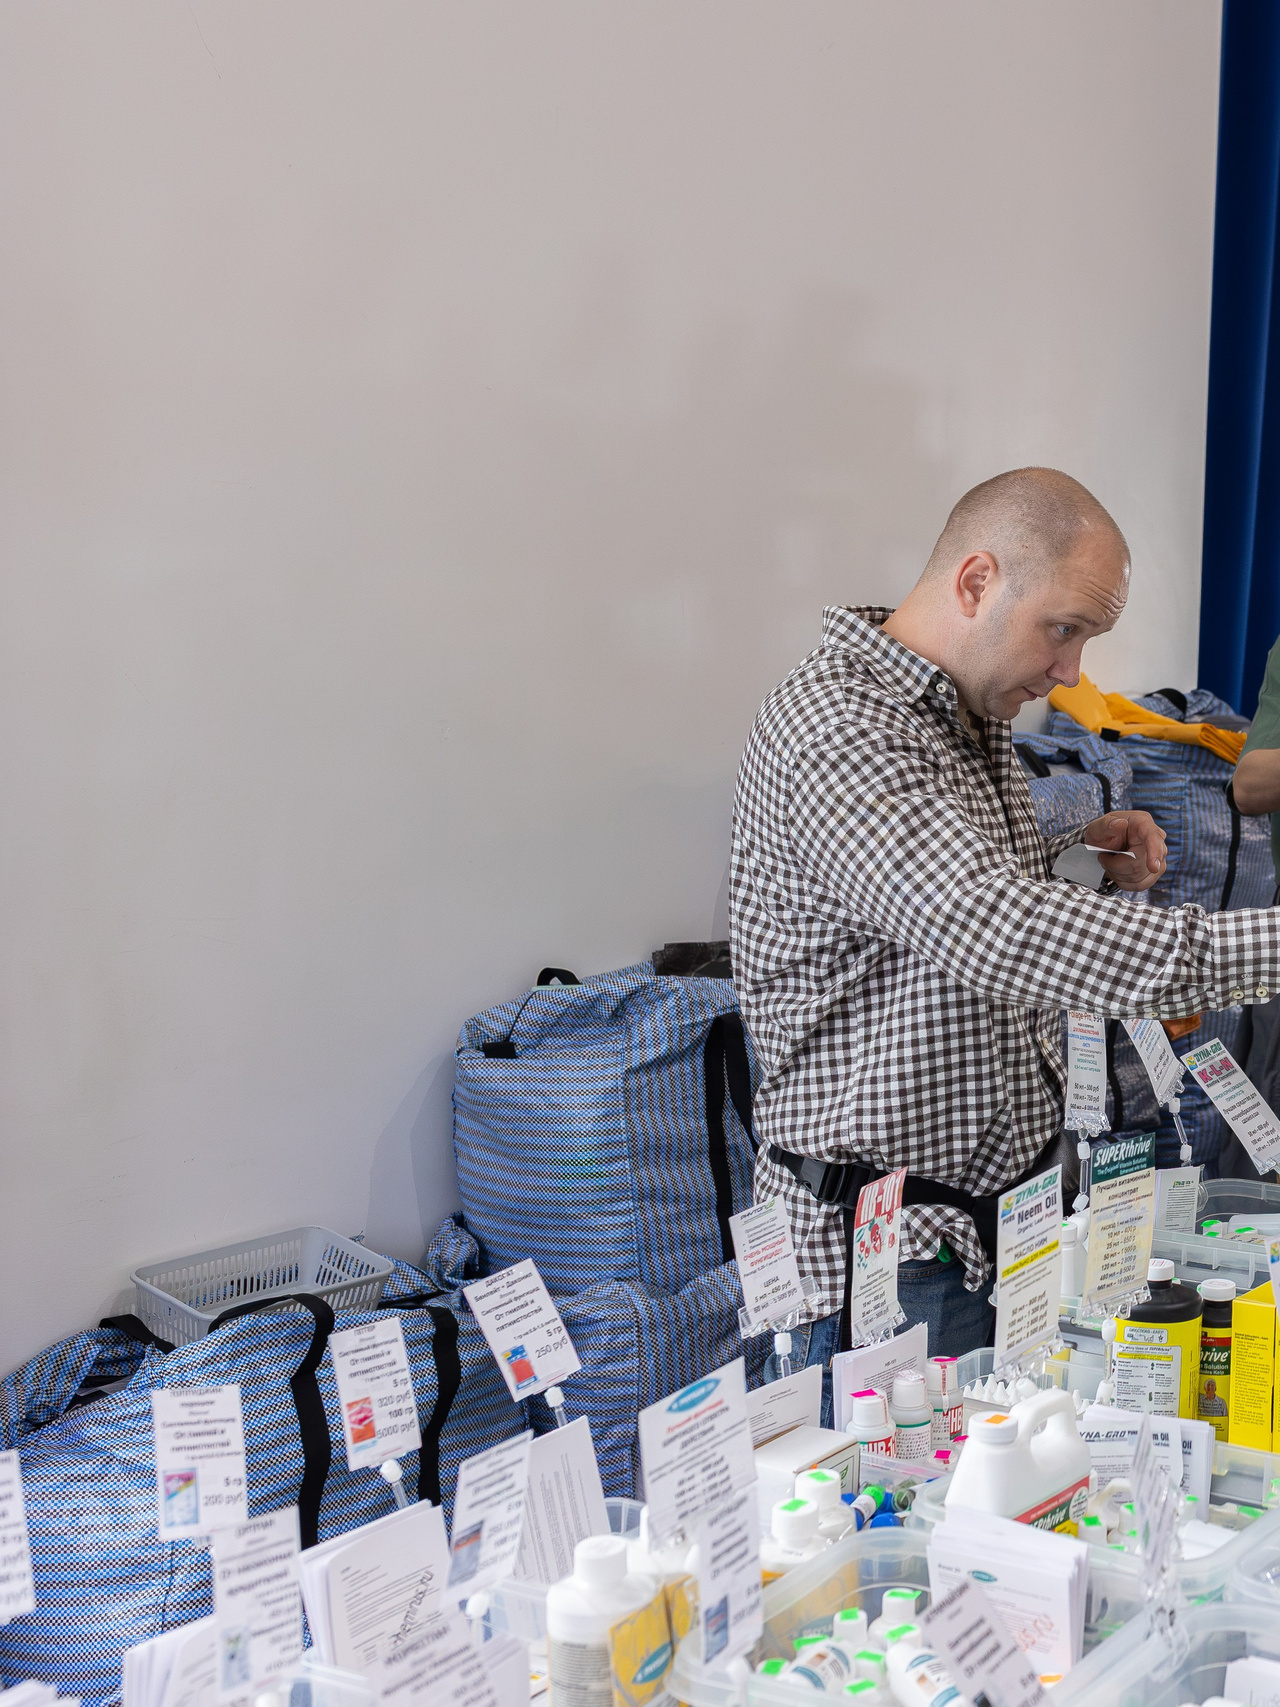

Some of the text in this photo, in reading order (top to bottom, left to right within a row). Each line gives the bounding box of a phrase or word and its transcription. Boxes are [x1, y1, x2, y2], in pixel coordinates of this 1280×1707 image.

[1015, 1171, 1059, 1205] DYNA-GRO
[1096, 1172, 1151, 1194] Лучший витаминный
[860, 1172, 904, 1224] HB-101
[1108, 1187, 1139, 1201] концентрат
[1017, 1200, 1042, 1225] Neem
[1045, 1192, 1057, 1210] Oil
[743, 1236, 787, 1261] ОЧЕНЬ МОЩНЫЙ
[1035, 1236, 1048, 1250] НИМ
[764, 1276, 779, 1288] ЦЕНА
[782, 1280, 791, 1290] руб
[494, 1313, 504, 1322] От
[553, 1325, 563, 1335] гр
[535, 1335, 568, 1359] 250 руб
[395, 1390, 412, 1404] руб
[400, 1419, 416, 1435] руб
[1160, 1432, 1169, 1441] Oil
[1183, 1440, 1192, 1450] Oil
